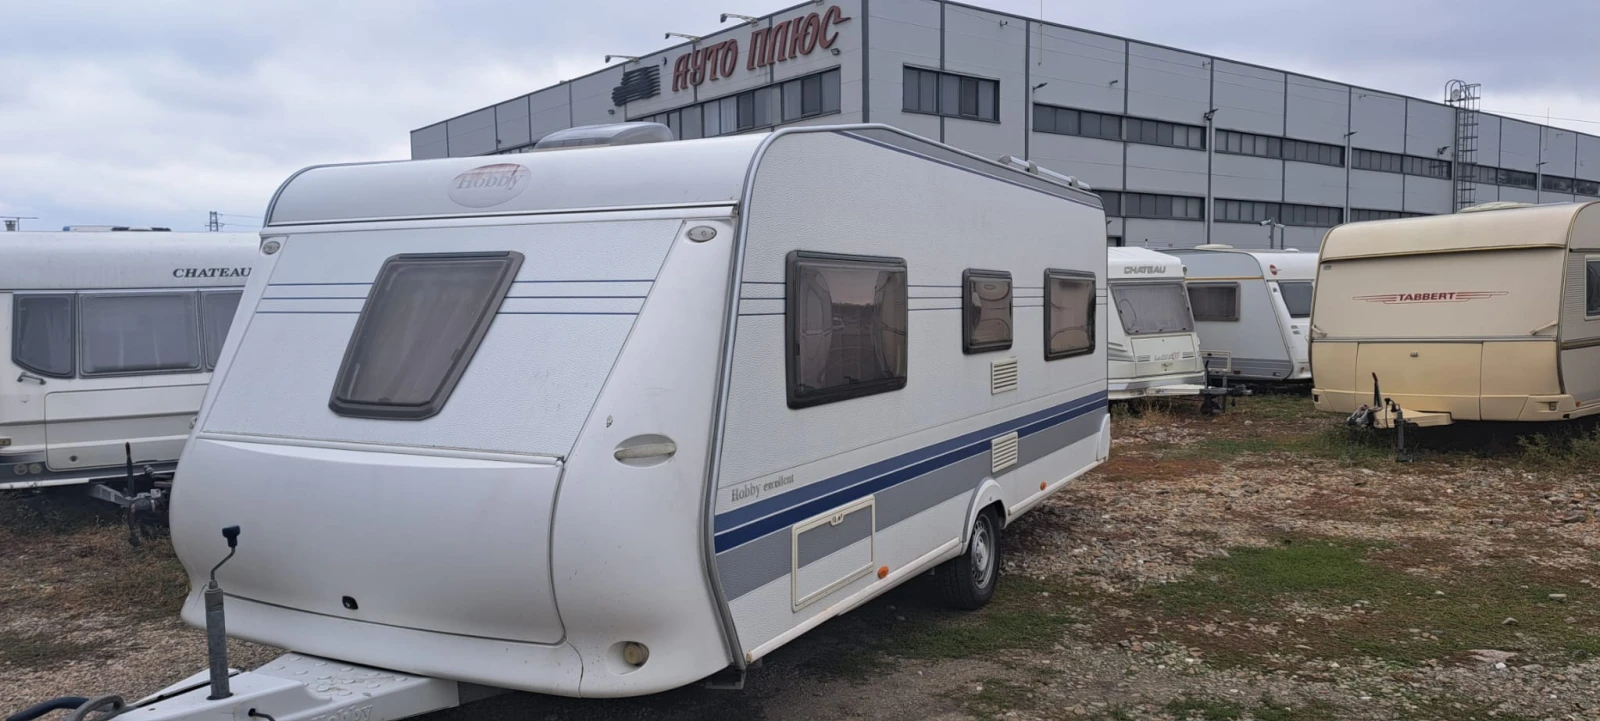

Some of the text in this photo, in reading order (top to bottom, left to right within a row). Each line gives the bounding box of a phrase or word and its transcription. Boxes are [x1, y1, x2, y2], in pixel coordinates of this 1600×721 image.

[672, 6, 852, 92] АУТО ПЛЮС
[456, 172, 524, 191] Hobby
[172, 267, 252, 278] CHATEAU
[1124, 265, 1166, 275] CHATEAU
[1398, 292, 1456, 301] TABBERT
[731, 483, 761, 502] Hobby
